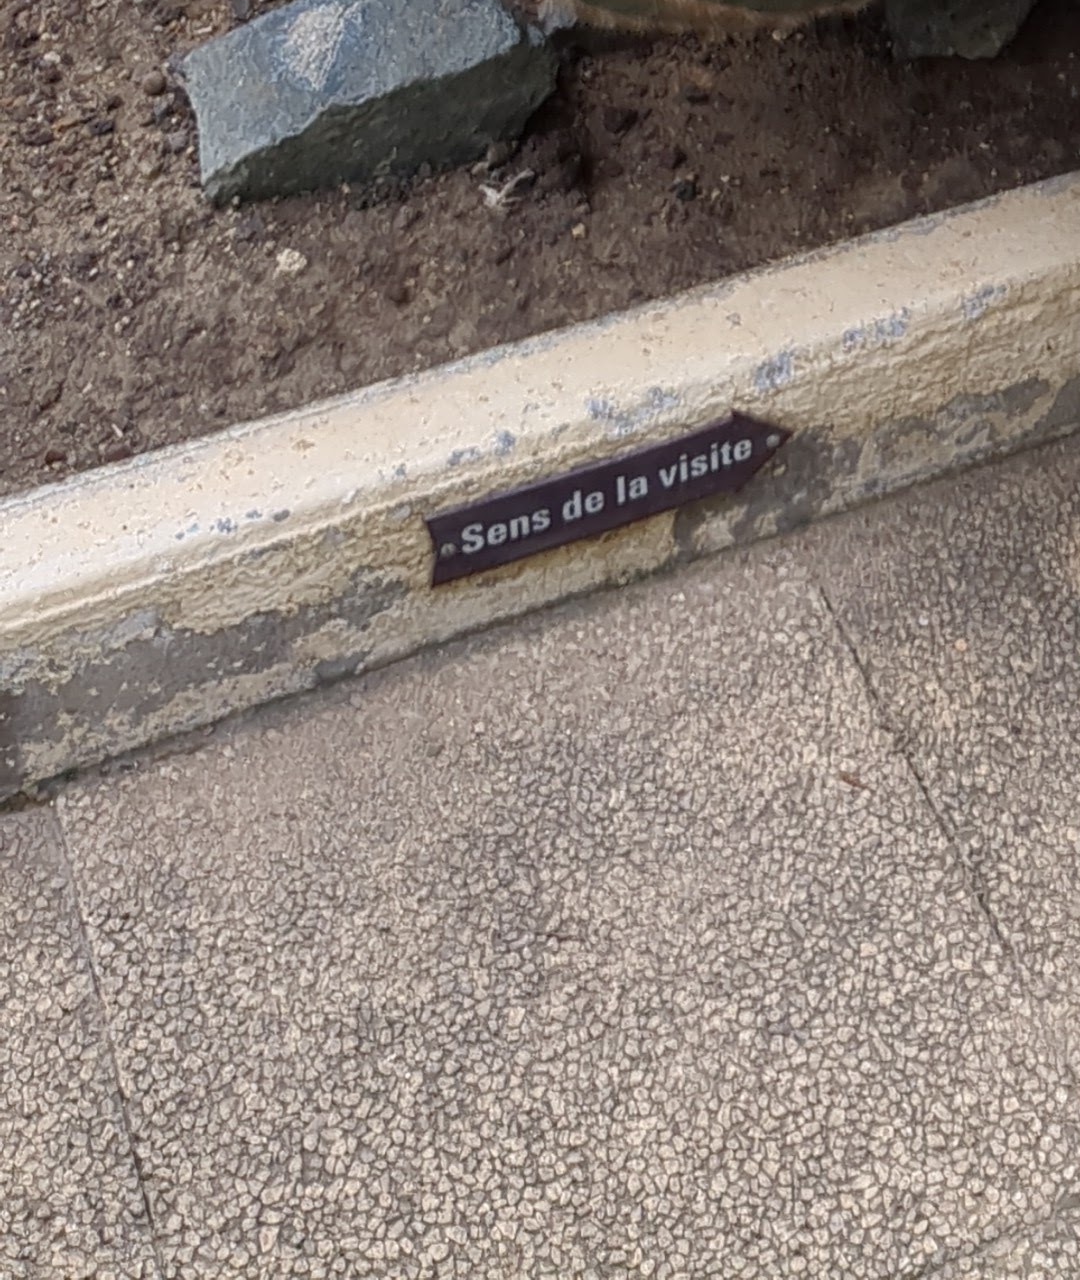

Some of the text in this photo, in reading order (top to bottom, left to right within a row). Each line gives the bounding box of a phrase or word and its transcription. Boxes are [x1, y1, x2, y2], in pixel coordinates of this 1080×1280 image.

[460, 438, 753, 554] Sens de la visite
